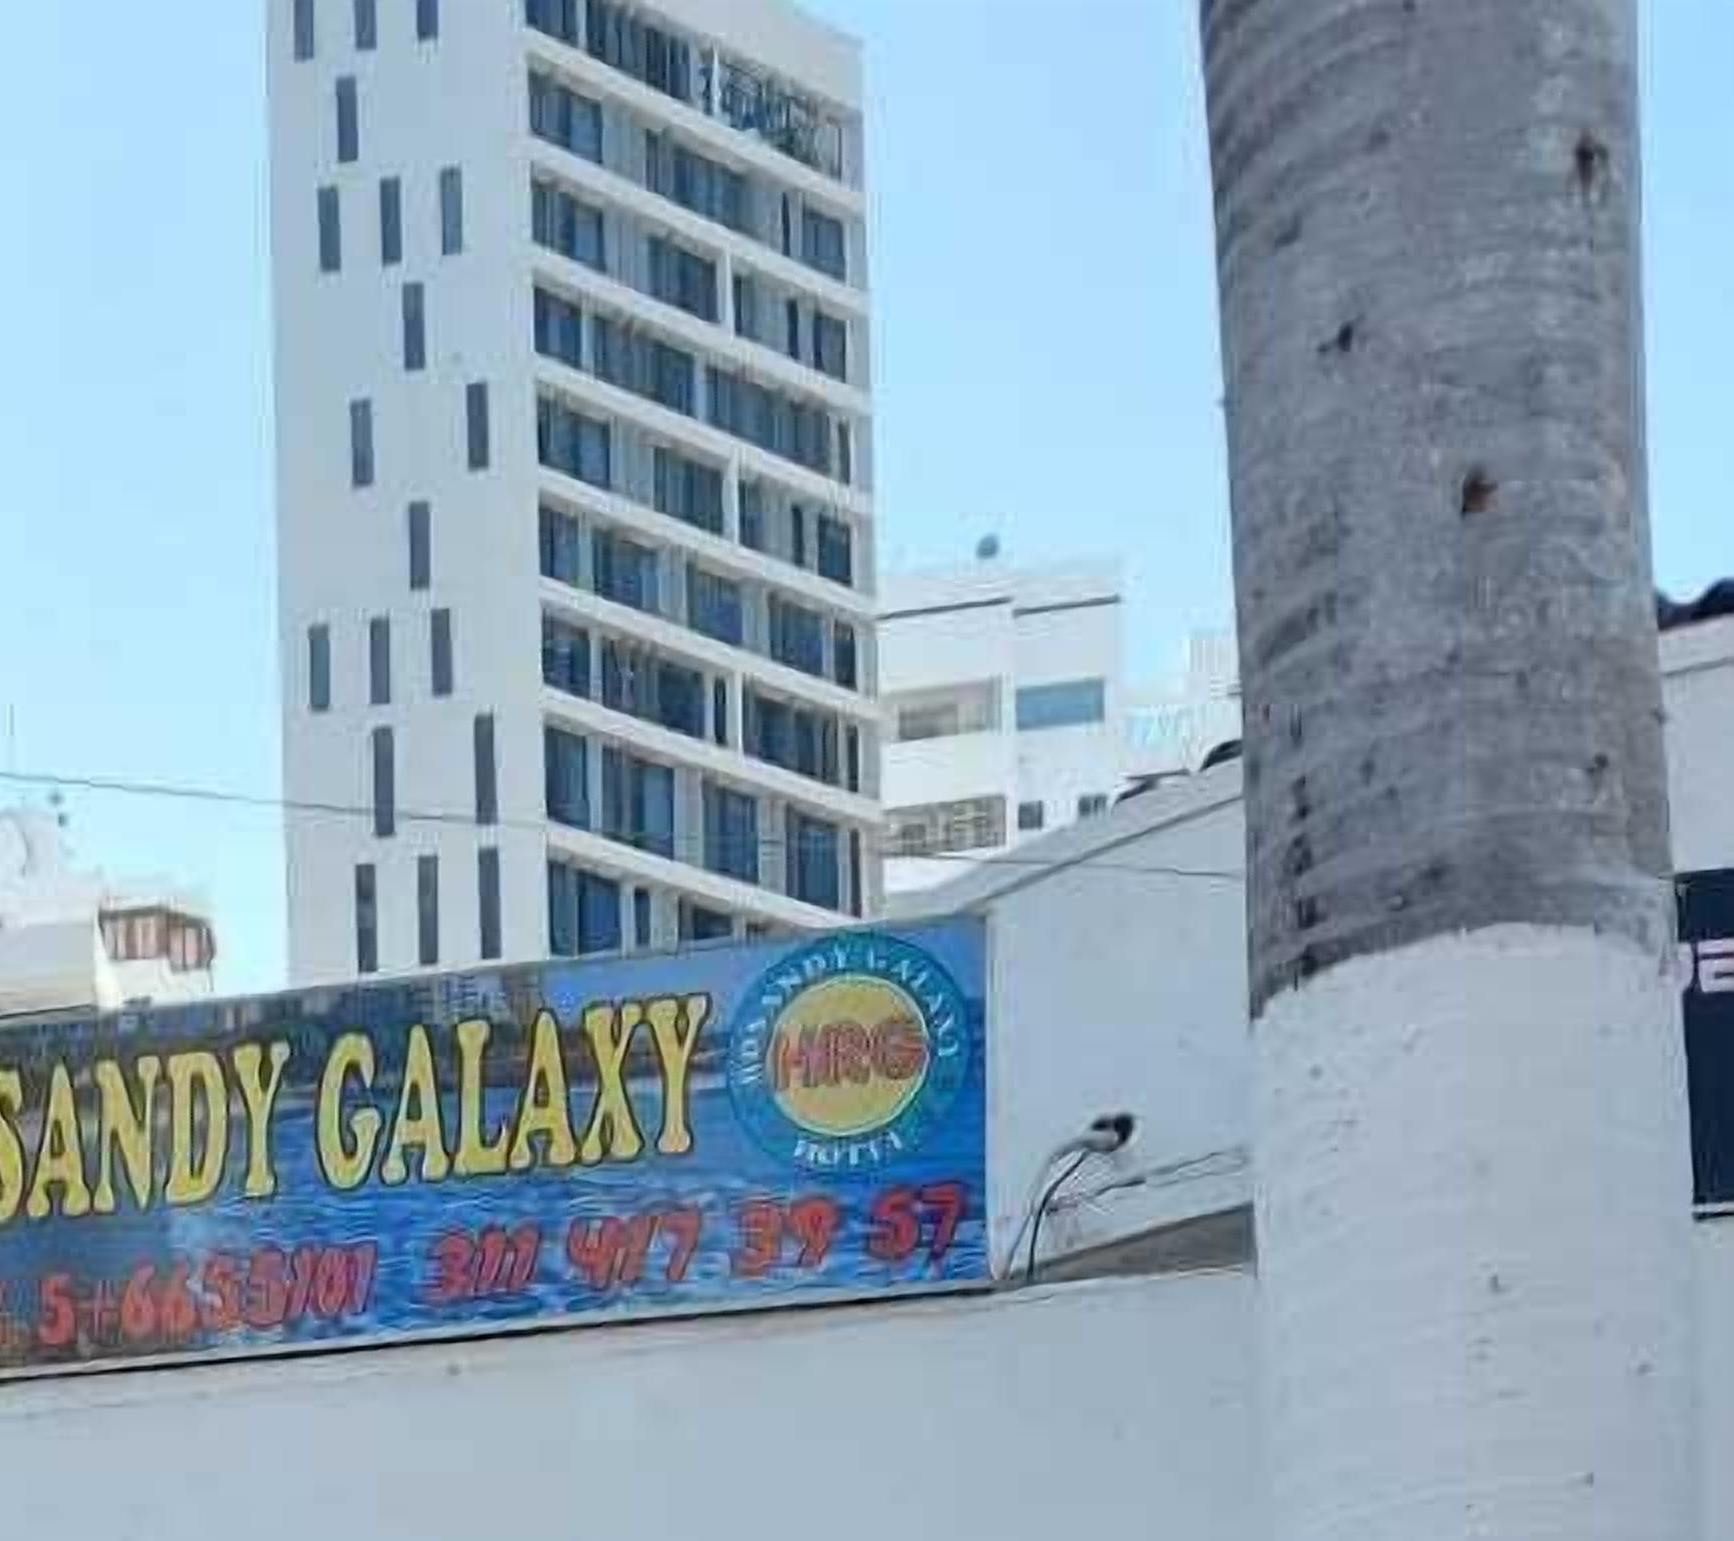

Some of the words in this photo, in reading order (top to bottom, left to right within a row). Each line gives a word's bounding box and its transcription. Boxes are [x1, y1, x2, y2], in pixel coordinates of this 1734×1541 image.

[316, 993, 712, 1191] GALAXY
[774, 1016, 930, 1090] HRG
[566, 1203, 700, 1292] 417
[869, 1181, 969, 1262] 57
